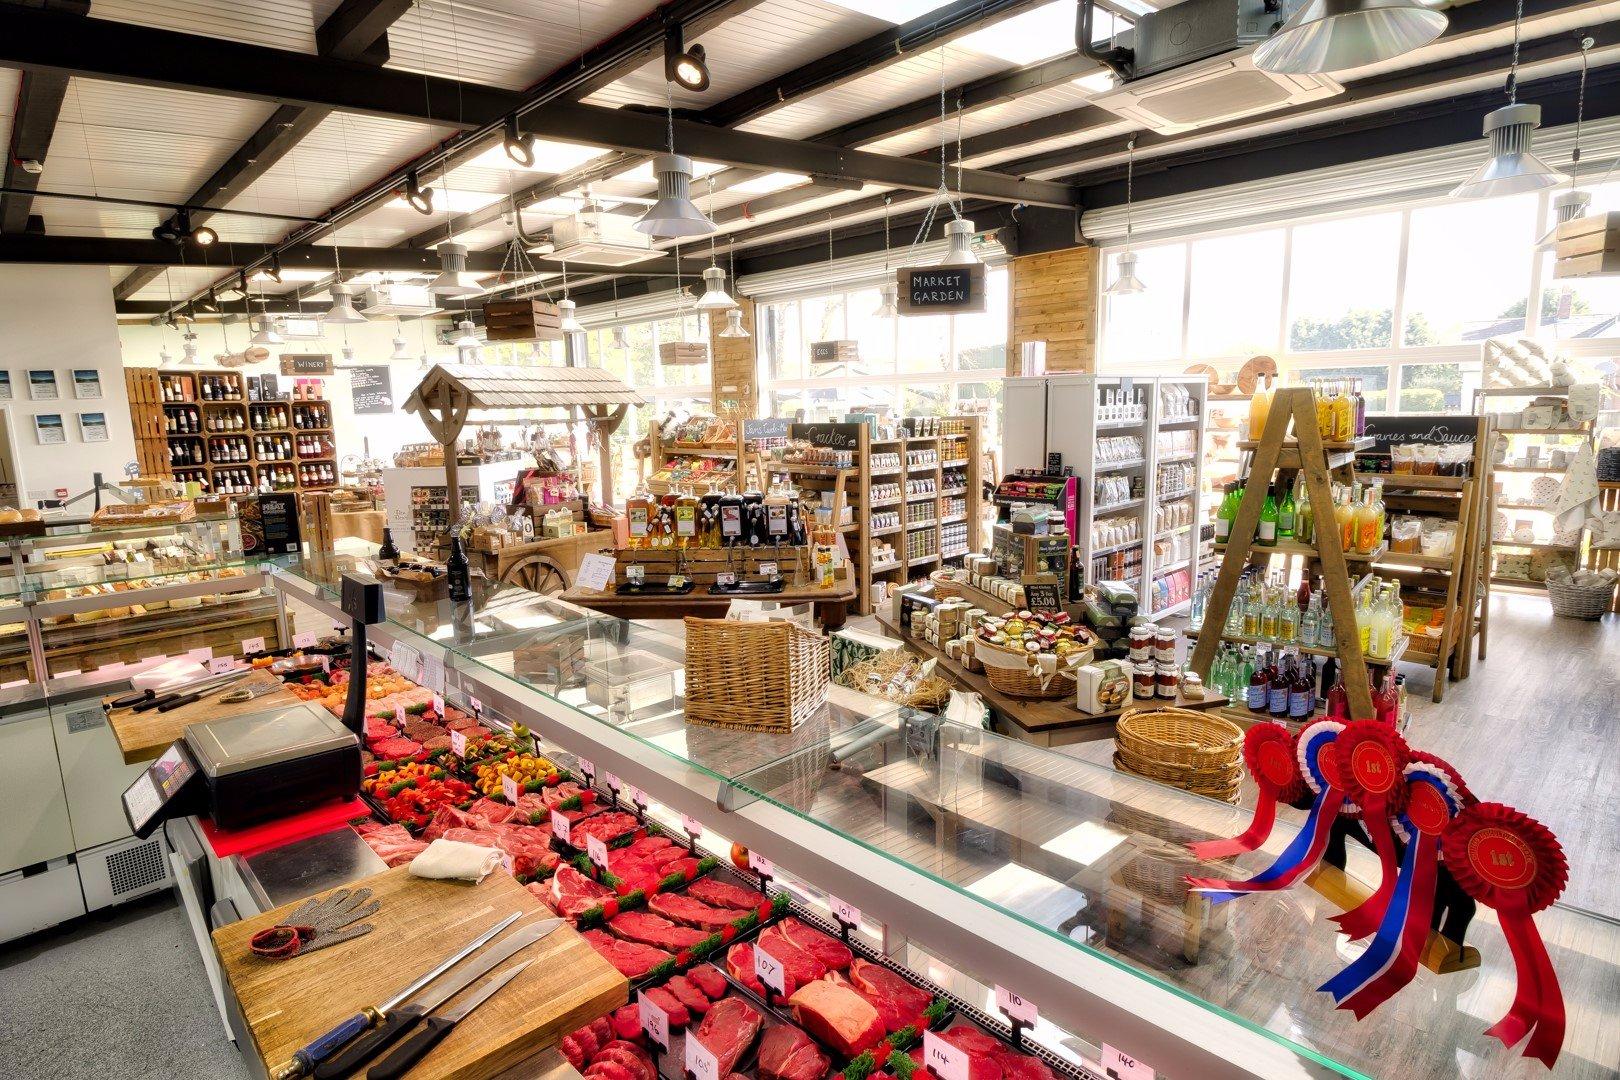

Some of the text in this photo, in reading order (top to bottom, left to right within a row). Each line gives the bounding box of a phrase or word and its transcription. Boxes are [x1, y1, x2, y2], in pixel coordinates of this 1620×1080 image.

[913, 276, 960, 287] MARKET
[913, 290, 964, 305] GARDEN
[296, 360, 325, 368] WINERY
[1409, 425, 1436, 441] and
[1434, 425, 1477, 443] Sauces
[1030, 597, 1056, 606] £5.00
[1365, 760, 1382, 774] 1st
[1489, 849, 1515, 867] 1st
[839, 905, 851, 918] 101
[757, 956, 776, 975] 107
[1009, 992, 1022, 1006] 110
[932, 1048, 950, 1065] 114
[1118, 1053, 1135, 1068] 140
